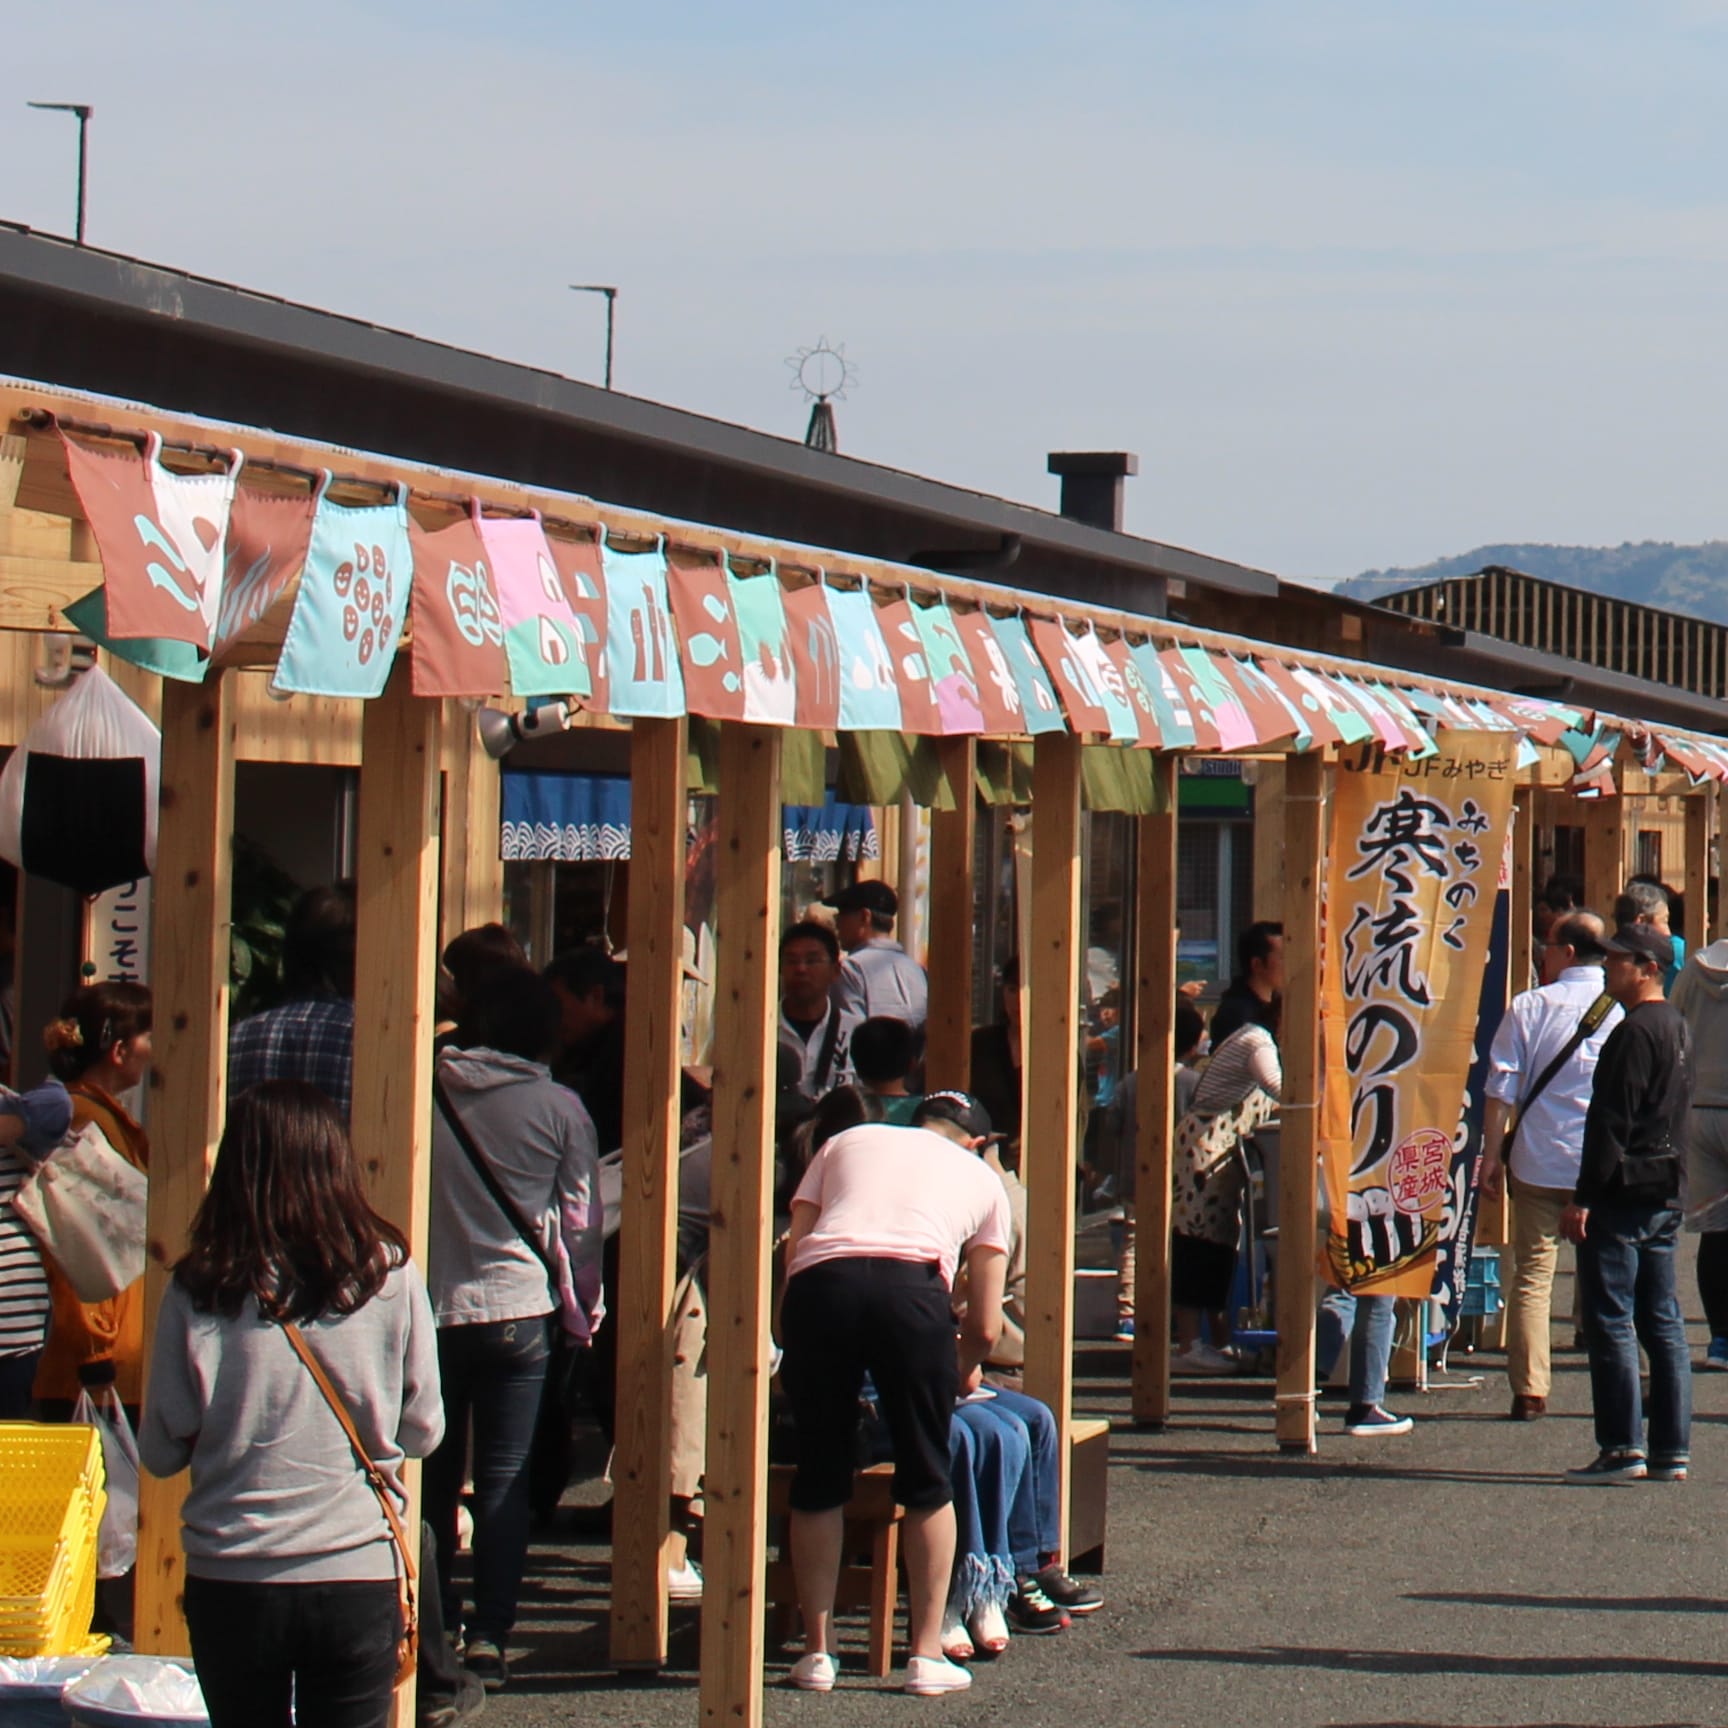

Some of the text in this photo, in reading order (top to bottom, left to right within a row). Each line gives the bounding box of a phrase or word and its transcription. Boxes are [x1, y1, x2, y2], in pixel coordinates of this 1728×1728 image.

[1404, 755, 1511, 780] JFみやぎ
[1443, 800, 1488, 949] みちのく
[1345, 789, 1450, 1178] 寒流のり
